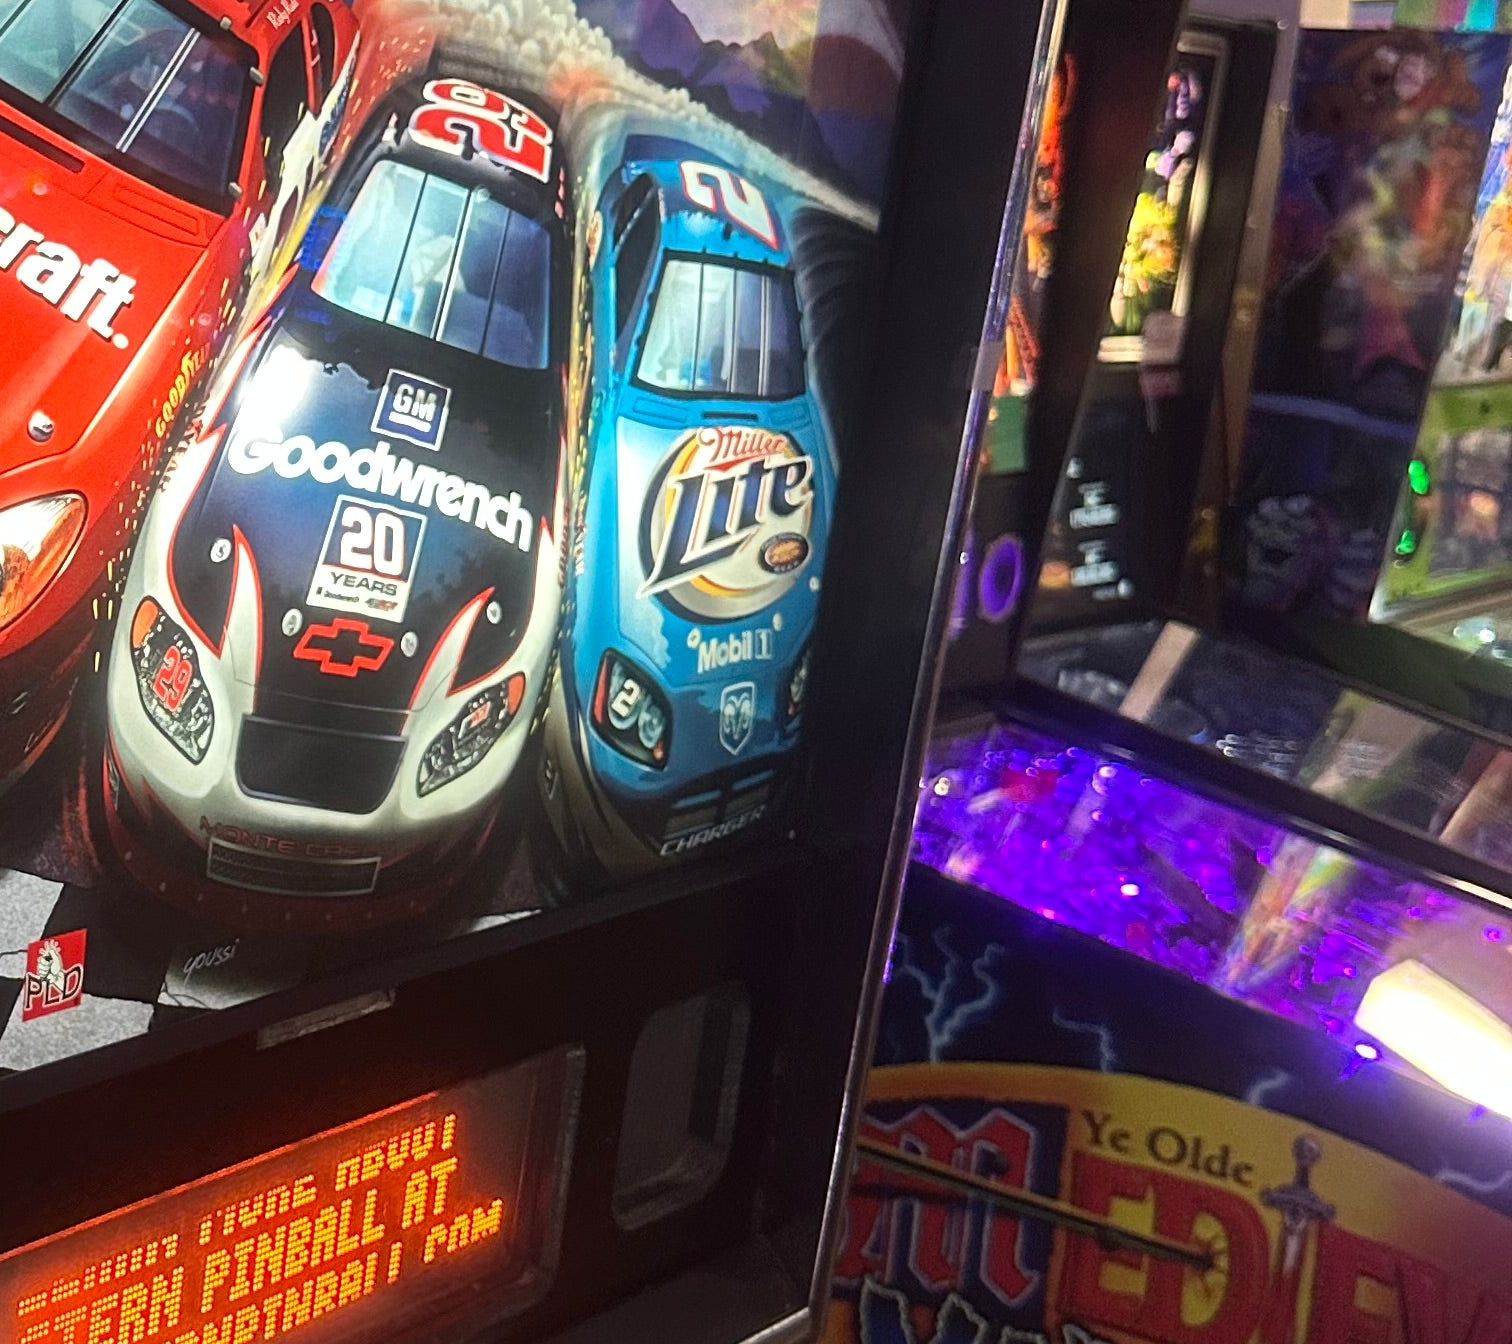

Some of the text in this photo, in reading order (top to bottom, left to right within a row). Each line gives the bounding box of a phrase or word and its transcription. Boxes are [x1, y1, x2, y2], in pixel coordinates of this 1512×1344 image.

[679, 159, 779, 251] 2
[392, 383, 438, 422] GM
[698, 427, 785, 462] Miller
[228, 423, 534, 553] Goodwrench
[340, 506, 406, 576] 20
[636, 454, 814, 598] Lite
[330, 571, 399, 597] YEARS
[153, 645, 192, 712] 29
[697, 632, 772, 674] Mobil 1
[610, 678, 640, 718] 2
[23, 963, 84, 1011] PLD
[1082, 1106, 1256, 1189] Ye Olde
[201, 1189, 386, 1313] PINBALL
[401, 1156, 458, 1229] AT
